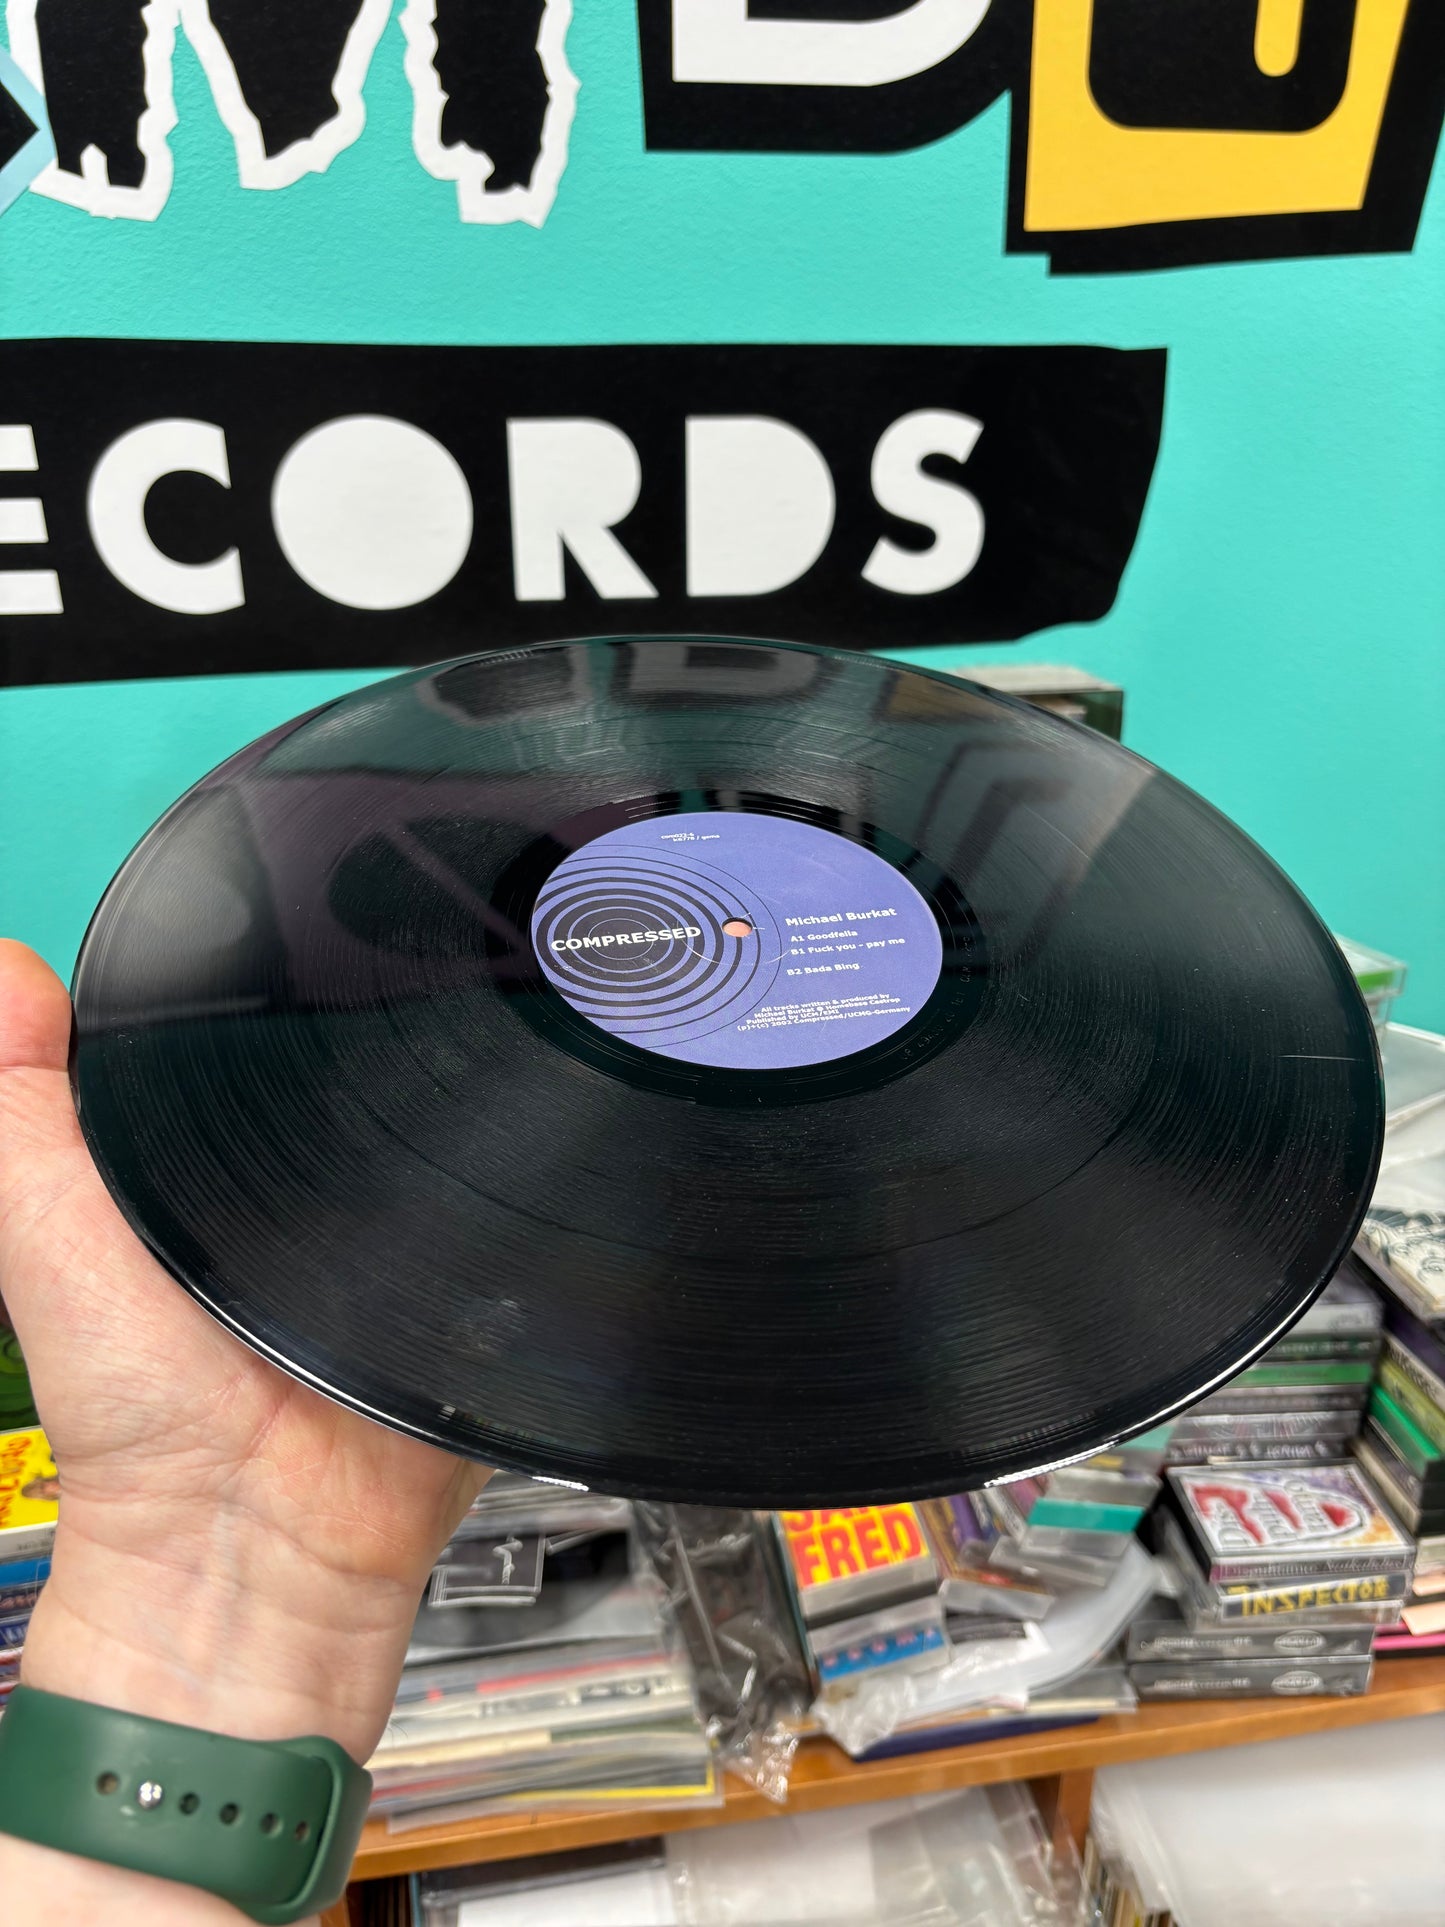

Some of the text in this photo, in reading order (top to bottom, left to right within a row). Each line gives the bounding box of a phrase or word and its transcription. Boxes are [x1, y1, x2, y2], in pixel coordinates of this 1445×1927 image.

[785, 908, 897, 926] Michael Burkat
[551, 927, 701, 951] COMPRESSED
[807, 930, 858, 941] Goodfella
[808, 945, 834, 954] Fuck
[836, 943, 857, 952] you
[866, 940, 886, 949] pay
[804, 965, 833, 974] Bada
[834, 963, 860, 971] Bing
[841, 994, 879, 1004] produced
[754, 1010, 786, 1019] Michael
[787, 1006, 815, 1015] Burkat
[825, 1001, 869, 1011] Homebase
[869, 997, 901, 1005] Castrop
[746, 1015, 787, 1025] Published
[737, 1023, 769, 1032] (p)+(c)
[793, 1508, 922, 1588] FRED
[1241, 1576, 1389, 1617] INSPECTOR
